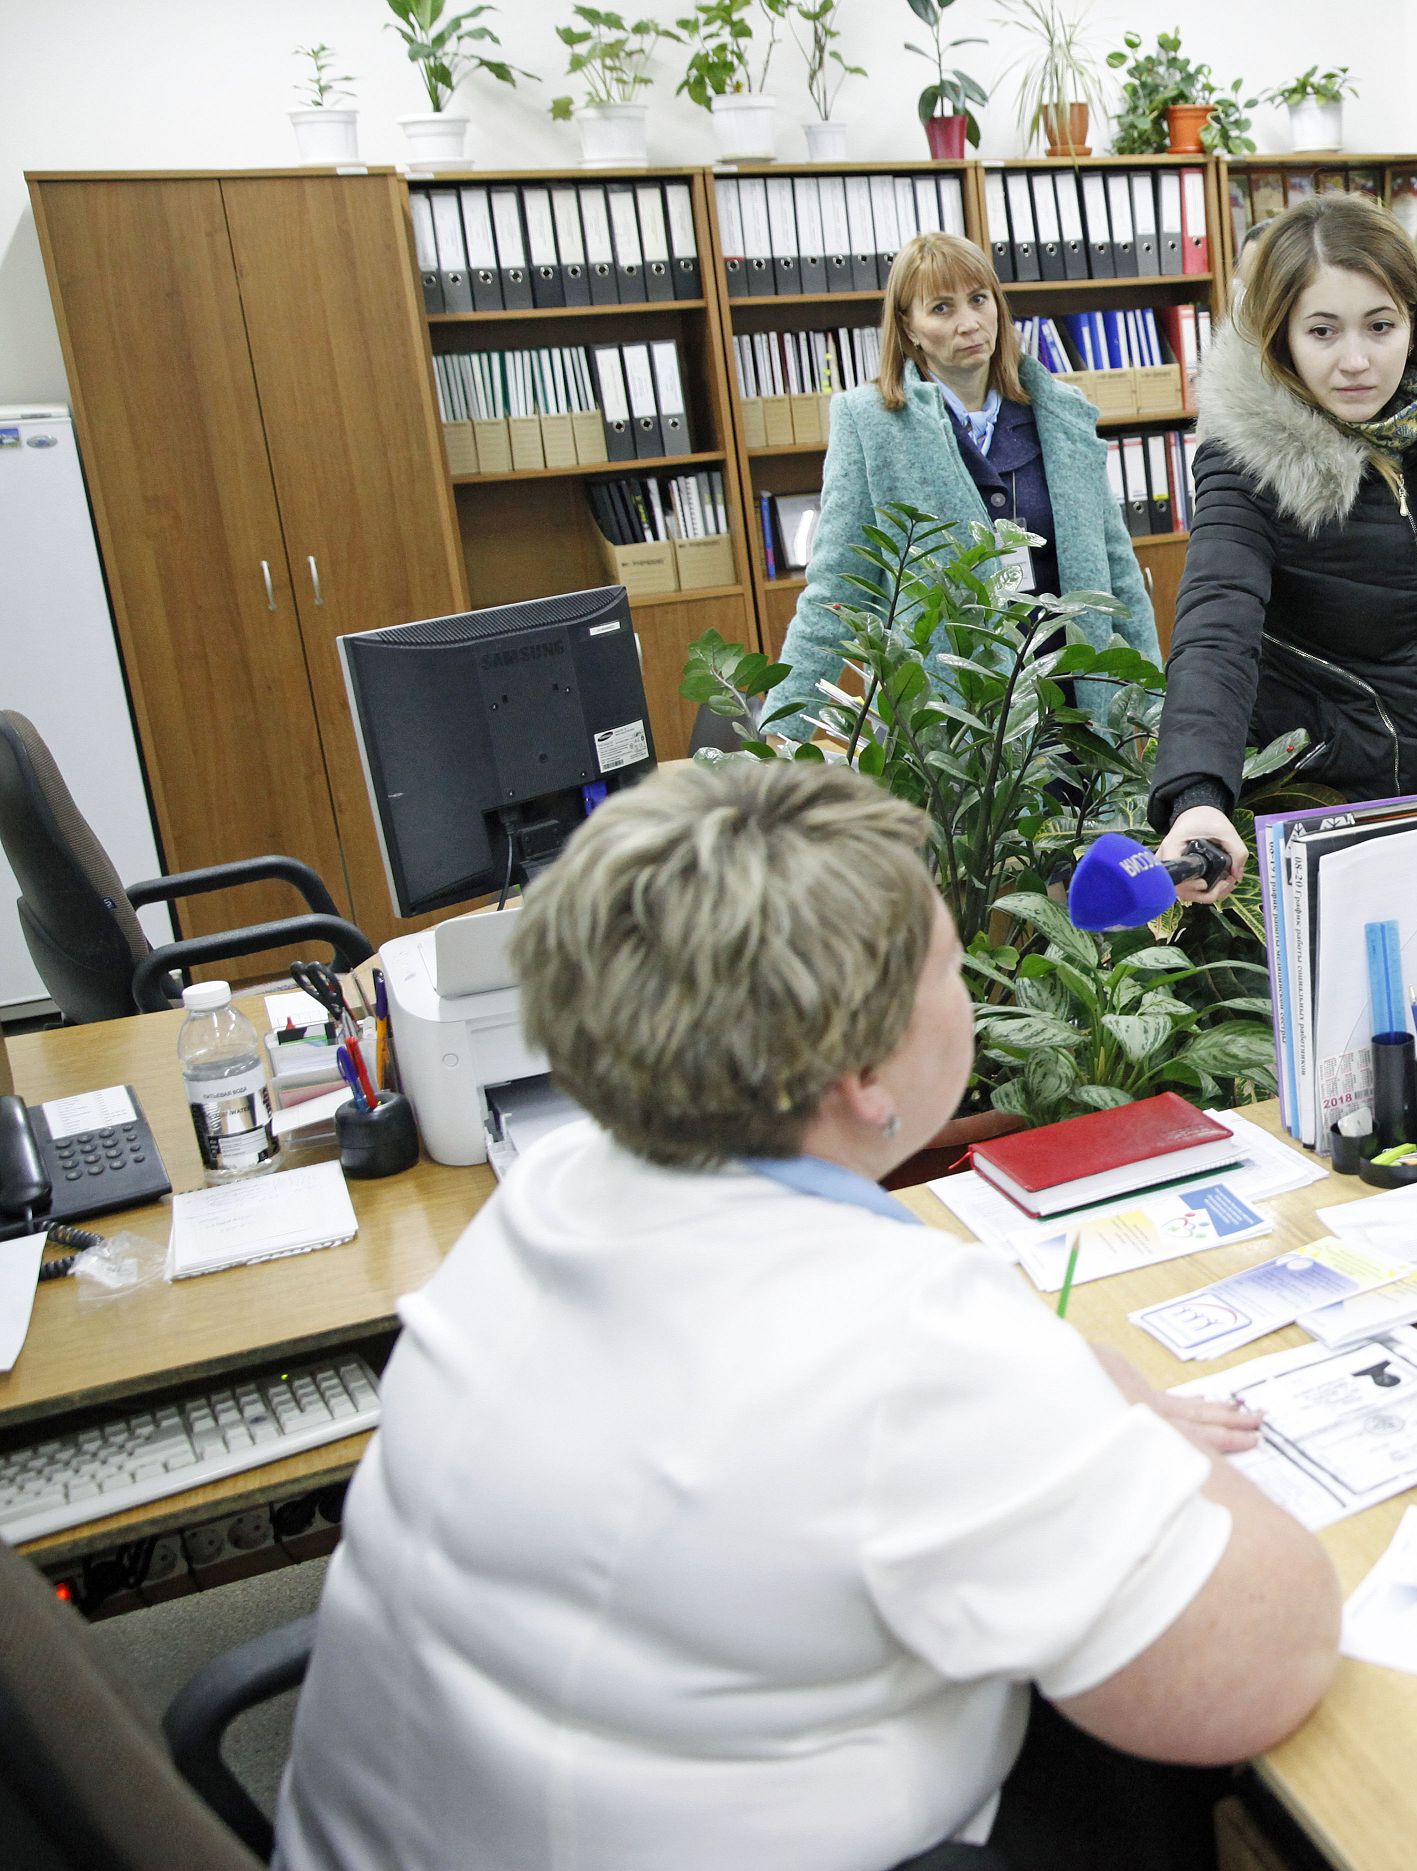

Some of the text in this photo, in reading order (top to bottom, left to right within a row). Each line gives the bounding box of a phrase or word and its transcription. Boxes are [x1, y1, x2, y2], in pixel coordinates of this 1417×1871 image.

[481, 640, 564, 671] SAMSUNG
[1119, 851, 1161, 877] ССИЯ
[1294, 856, 1307, 1076] 08-20 График работы социальных работников
[1323, 1093, 1353, 1109] 2018
